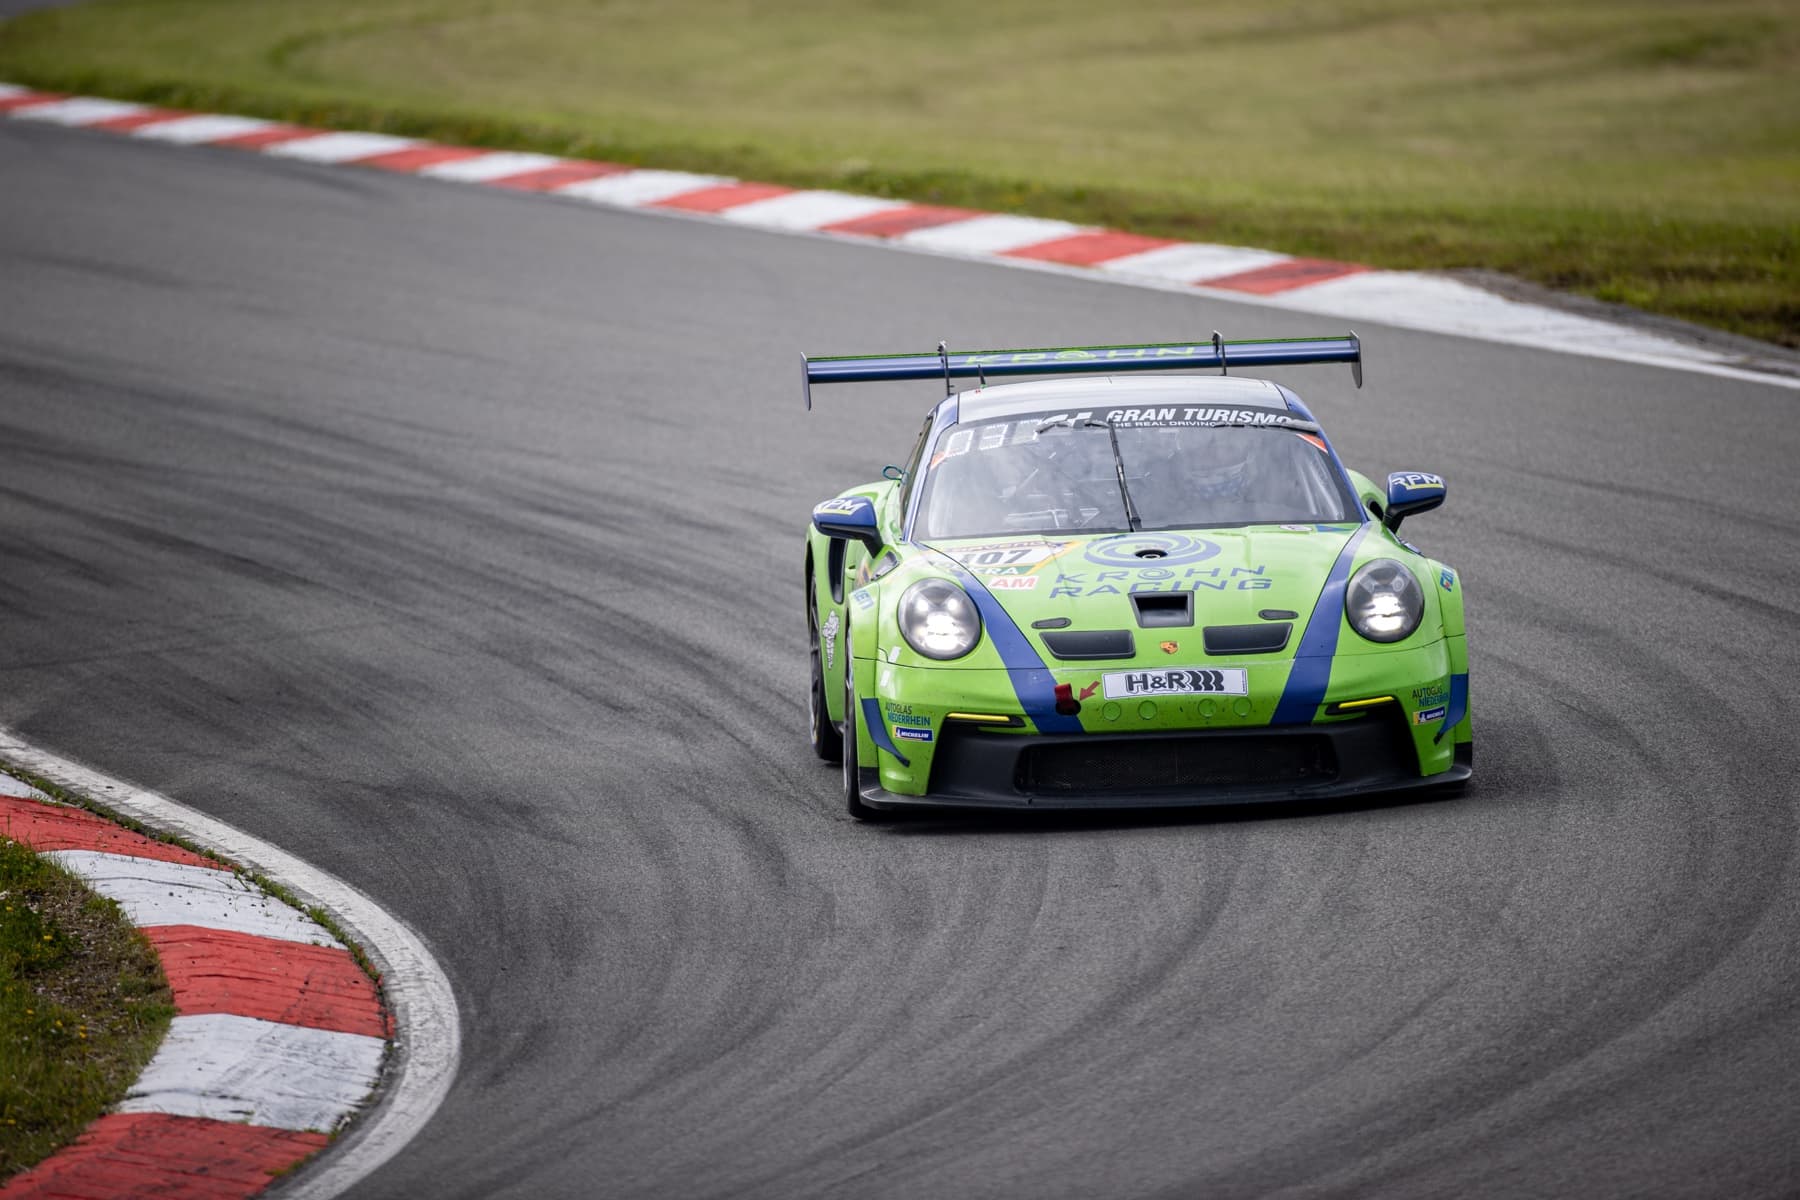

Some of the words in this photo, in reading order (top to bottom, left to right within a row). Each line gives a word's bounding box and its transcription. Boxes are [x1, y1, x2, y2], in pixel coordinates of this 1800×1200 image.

[965, 348, 1196, 364] KROHN
[1106, 408, 1176, 423] GRAN
[1183, 408, 1292, 425] TURISMO
[1391, 474, 1444, 491] RPM
[991, 577, 1036, 588] AM
[1055, 566, 1265, 584] KROHN
[1049, 577, 1273, 599] RACING
[1126, 671, 1187, 693] H&R
[885, 702, 912, 714] AUTOGLAS
